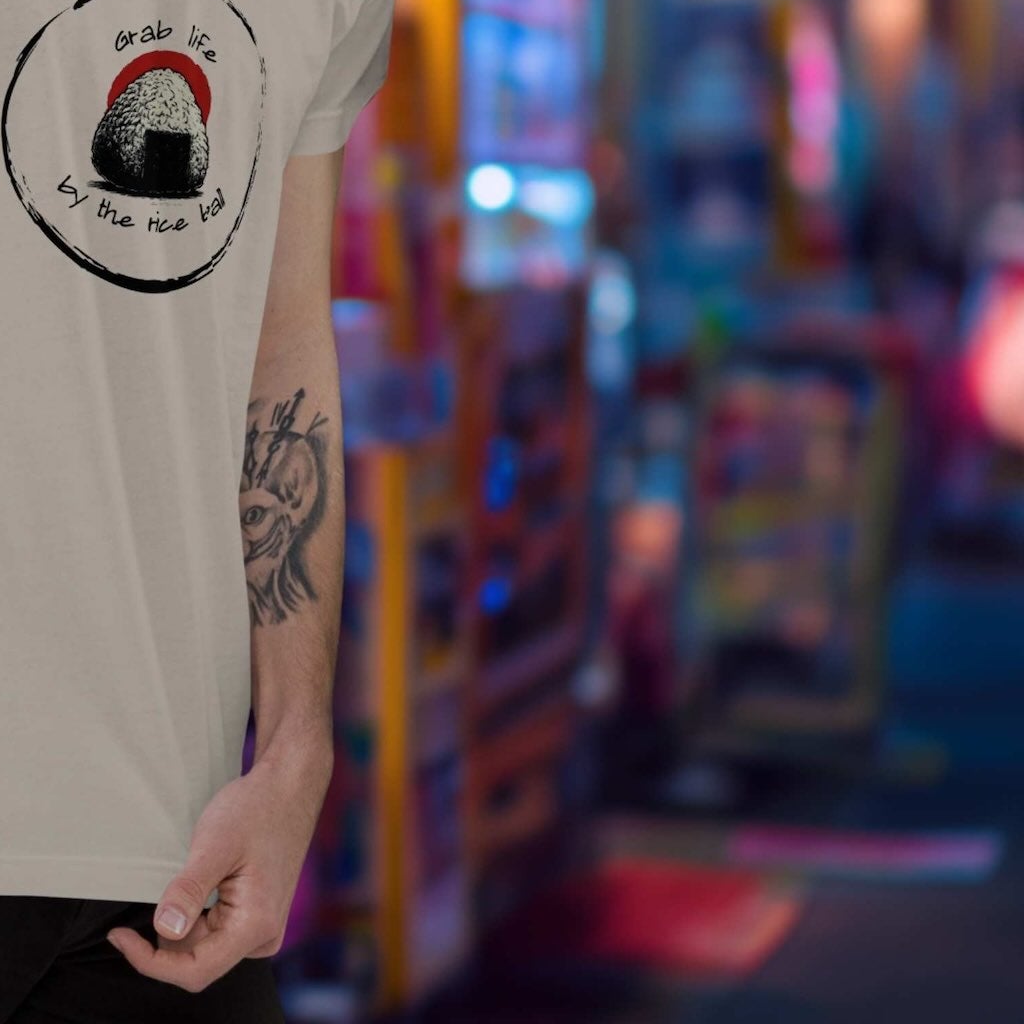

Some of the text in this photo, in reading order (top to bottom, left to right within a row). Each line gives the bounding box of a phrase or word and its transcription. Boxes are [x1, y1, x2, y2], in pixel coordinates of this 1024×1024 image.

[115, 20, 217, 63] Grab life
[57, 175, 226, 233] by the rice ball
